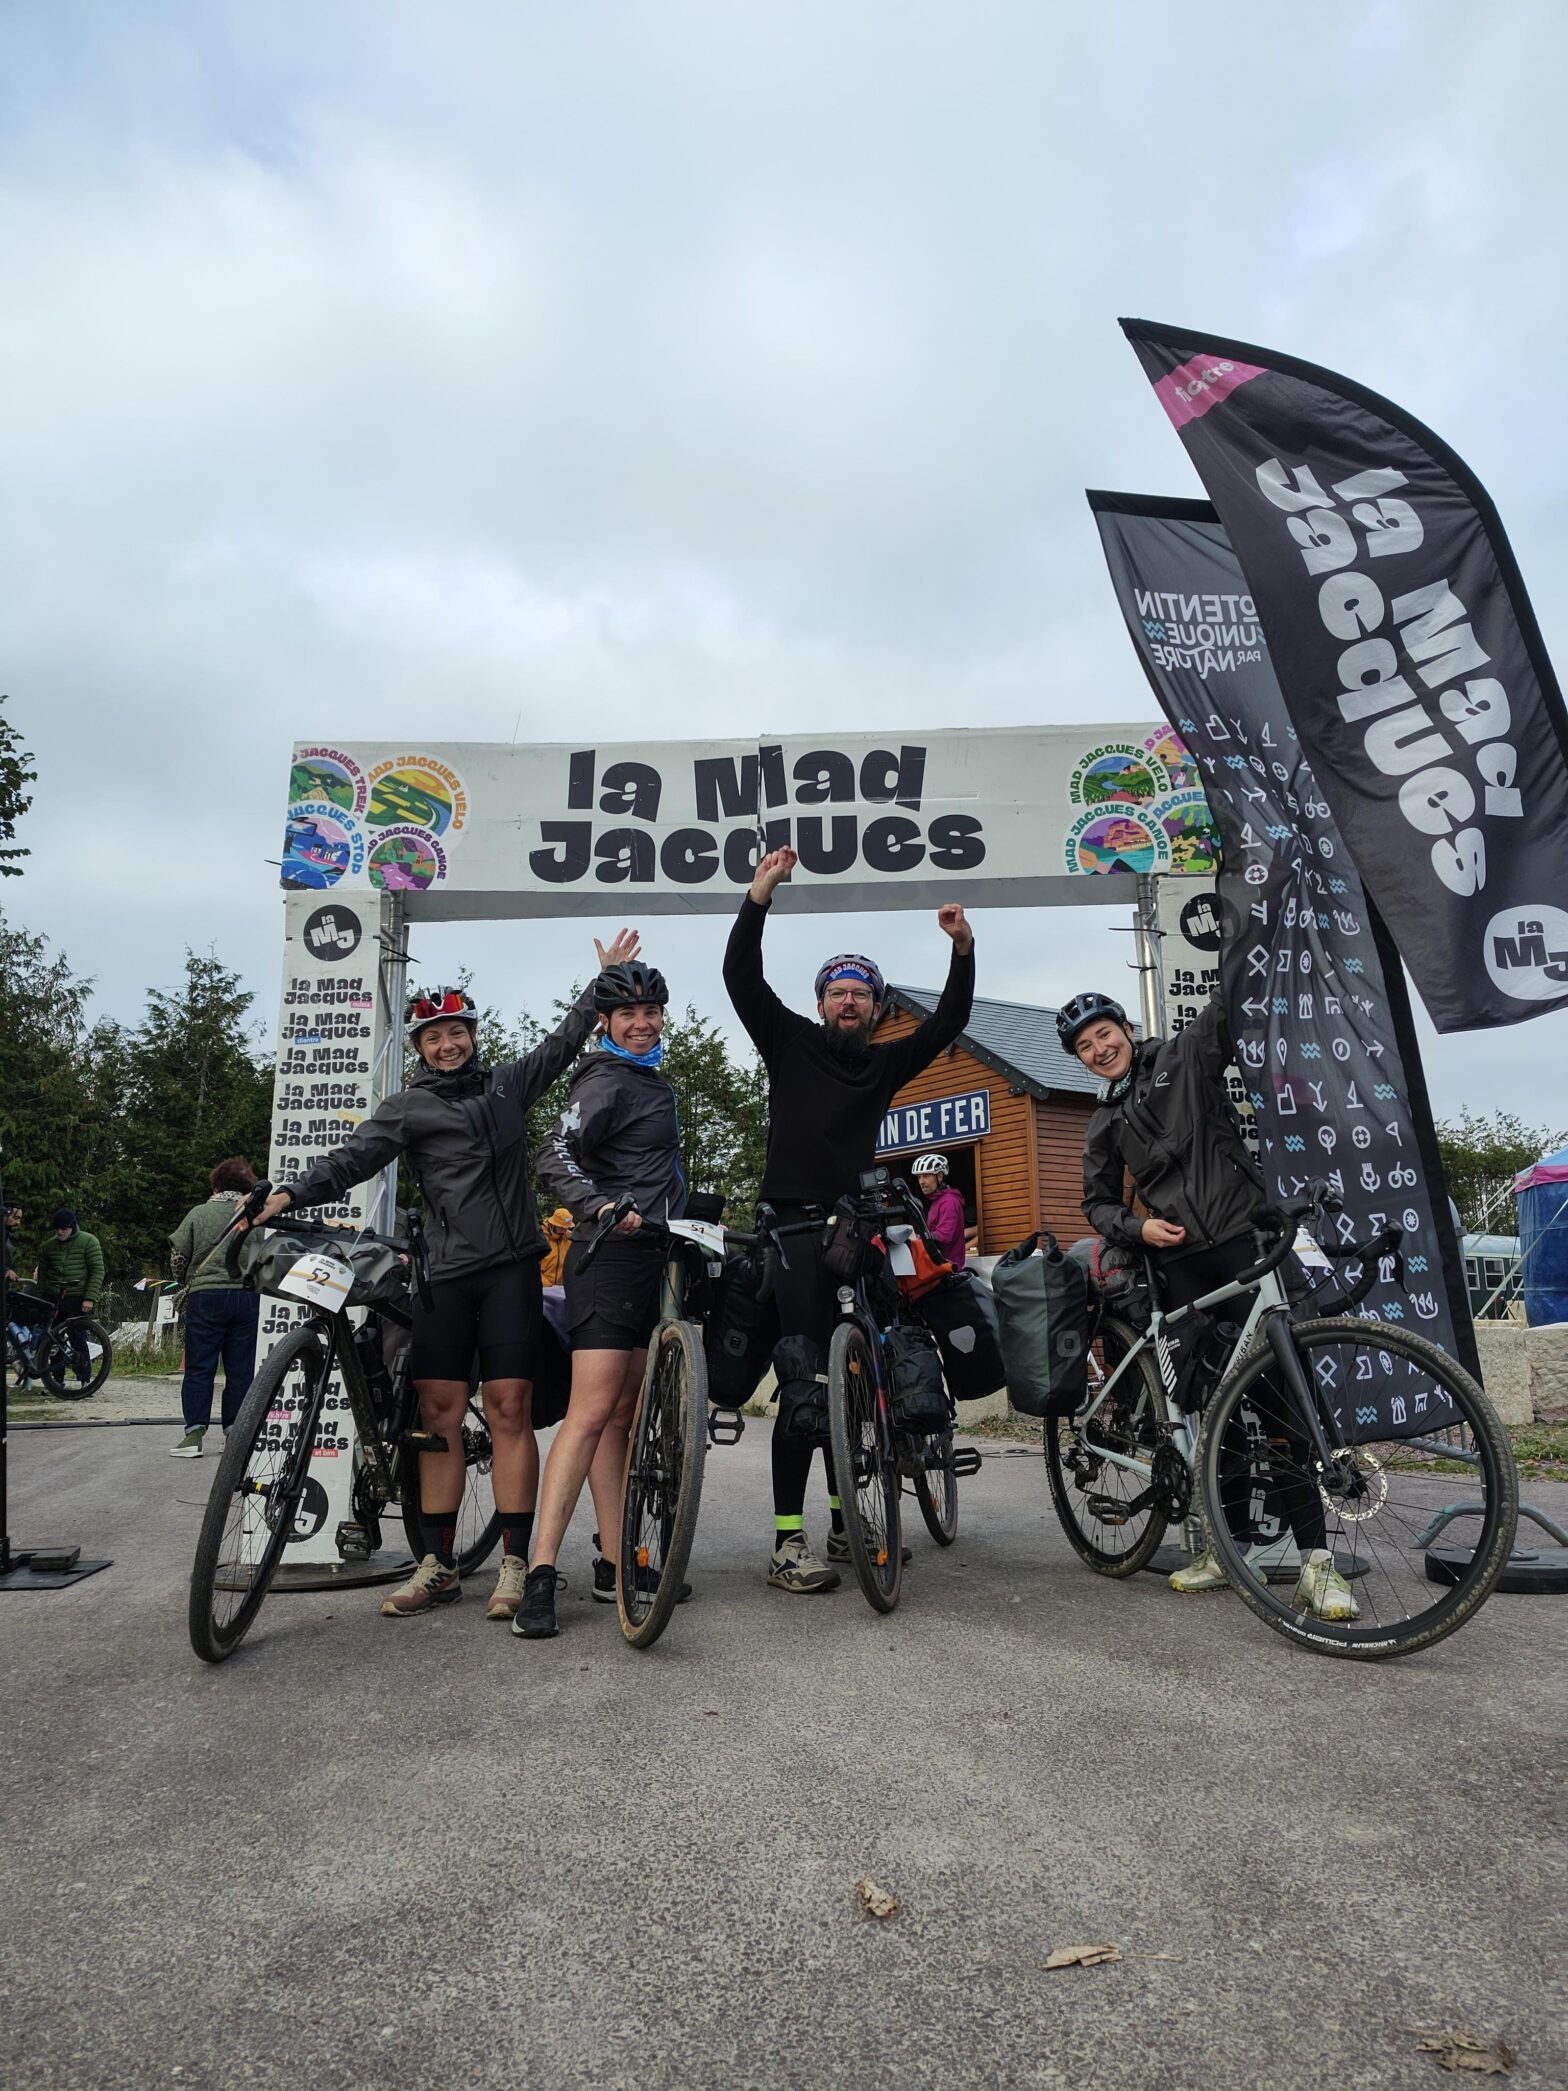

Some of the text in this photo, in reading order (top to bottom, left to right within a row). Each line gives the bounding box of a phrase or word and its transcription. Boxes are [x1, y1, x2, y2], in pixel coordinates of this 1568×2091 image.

[1331, 466, 1524, 817] la Mad
[1255, 457, 1487, 897] Jacques
[300, 747, 367, 814] JACQUES TREK
[1069, 770, 1083, 804] MAD
[1079, 744, 1145, 770] JACQUES
[1145, 756, 1168, 793] VELO
[568, 744, 927, 823] la Mad
[396, 756, 461, 791] JACQUES
[452, 791, 467, 830] VELO
[1152, 791, 1207, 820] ACQUE
[1065, 804, 1169, 873] MAD JACQUES CANOE
[351, 832, 364, 874] STOP
[378, 826, 433, 843] JACQUES
[431, 840, 447, 880] CANOE
[528, 813, 986, 883] Jacques
[321, 914, 336, 925] la
[1517, 920, 1544, 935] la
[310, 922, 355, 949] MJ
[1175, 968, 1195, 983] la
[291, 977, 363, 992] la Mad
[284, 991, 373, 1005] Jacques
[1177, 1004, 1197, 1018] la
[289, 1012, 361, 1027] la Mad
[281, 1026, 371, 1040] Jacques
[287, 1047, 359, 1062] la Mad
[279, 1061, 369, 1075] Jacques
[284, 1083, 358, 1097] la Mad
[277, 1097, 367, 1111] Jacques
[282, 1119, 355, 1133] la Mad
[905, 1107, 933, 1142] DE
[940, 1096, 985, 1136] FER
[274, 1133, 353, 1147] Jacque
[280, 1155, 300, 1170] la
[306, 1267, 331, 1287] 52
[271, 1304, 290, 1320] la
[1306, 1633, 1348, 1648] POWER
